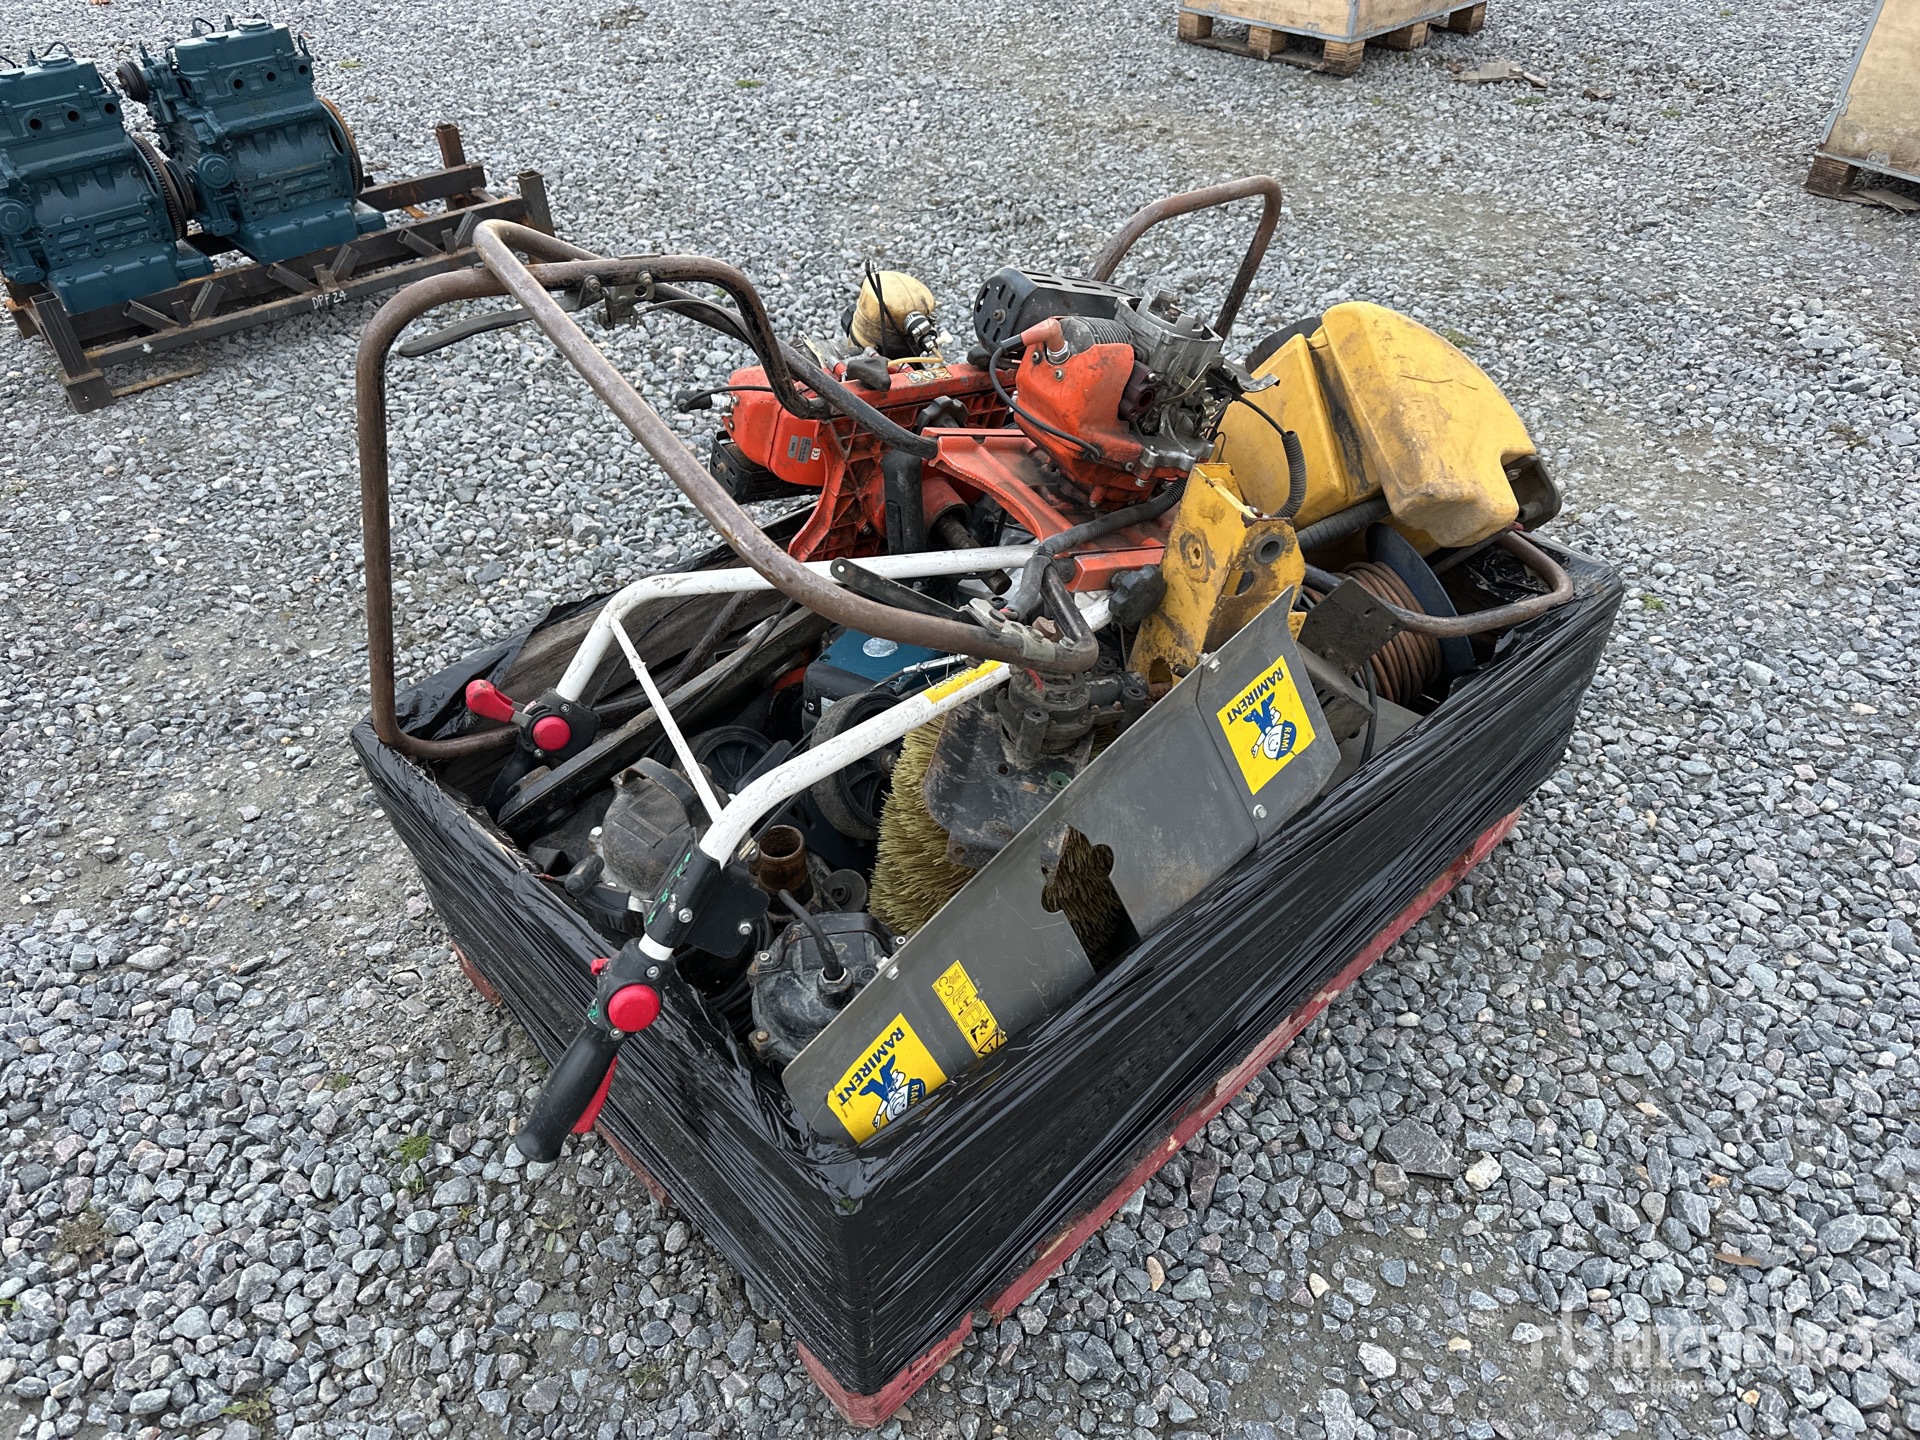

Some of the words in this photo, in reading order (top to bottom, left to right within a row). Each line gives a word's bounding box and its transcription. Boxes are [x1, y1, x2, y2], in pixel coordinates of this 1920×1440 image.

[312, 294, 330, 310] DPF
[333, 290, 347, 303] 24
[1226, 666, 1285, 726] RAMIRENT
[1280, 726, 1292, 752] RAMI
[838, 1026, 906, 1107] RAMIRENT
